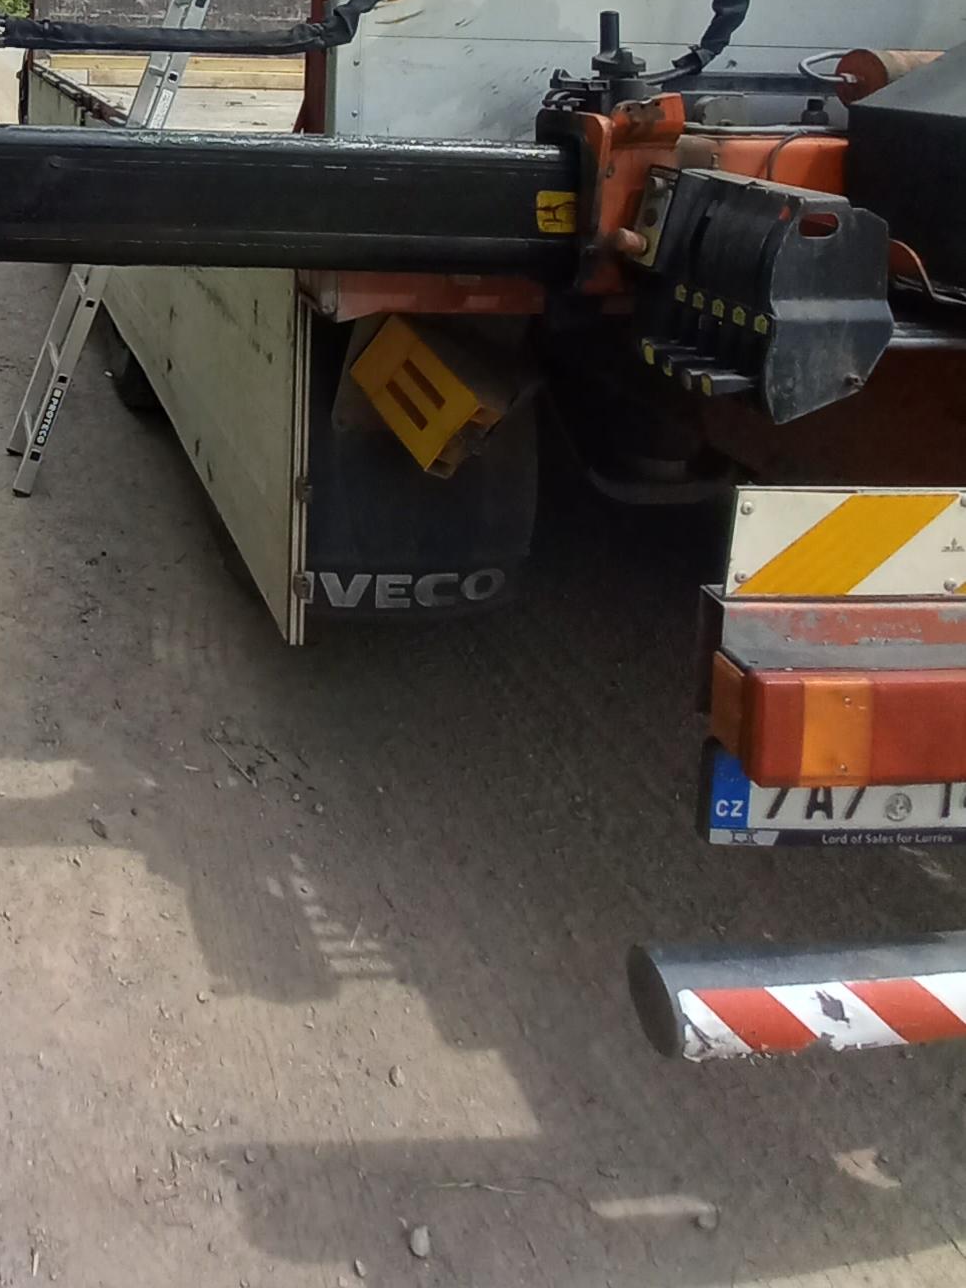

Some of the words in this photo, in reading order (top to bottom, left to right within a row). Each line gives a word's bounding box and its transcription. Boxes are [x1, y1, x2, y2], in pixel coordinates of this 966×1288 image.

[36, 397, 59, 445] PROTECO
[716, 799, 744, 818] CZ
[822, 834, 848, 844] Lord
[850, 834, 863, 843] of
[866, 833, 894, 843] Sales
[896, 833, 913, 843] for
